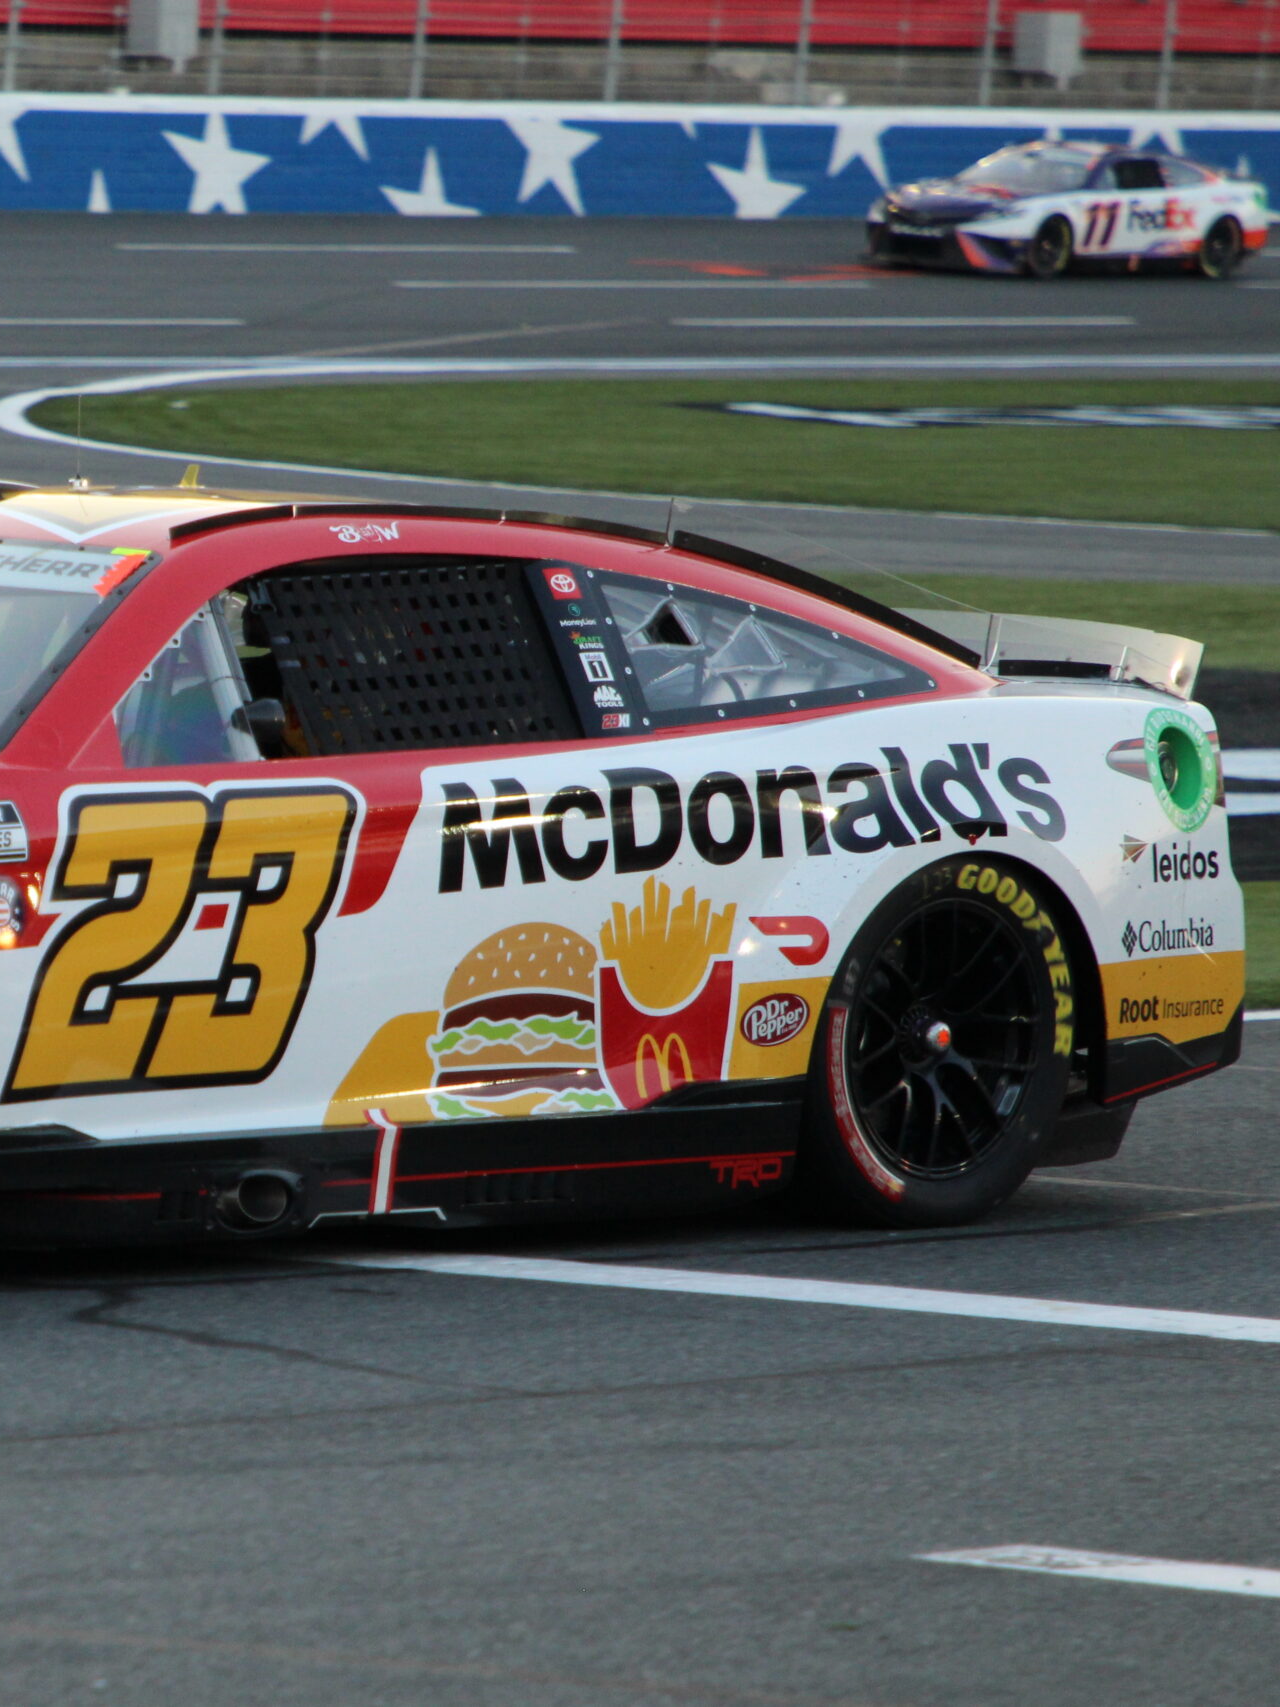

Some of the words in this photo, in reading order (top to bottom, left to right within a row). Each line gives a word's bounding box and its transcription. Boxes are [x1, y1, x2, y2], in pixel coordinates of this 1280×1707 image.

[578, 642, 605, 650] KINGS
[591, 661, 603, 677] 1
[602, 713, 630, 729] 23XI
[438, 743, 1066, 895] McDonald's
[1152, 841, 1220, 883] leidos
[1138, 917, 1214, 952] Columbia
[956, 863, 1073, 1058] GOODYEAR
[744, 1005, 803, 1041] Pepper
[766, 999, 789, 1021] Dr
[1119, 995, 1160, 1025] Root
[1162, 997, 1225, 1020] Insurance
[710, 1156, 783, 1190] TRD
